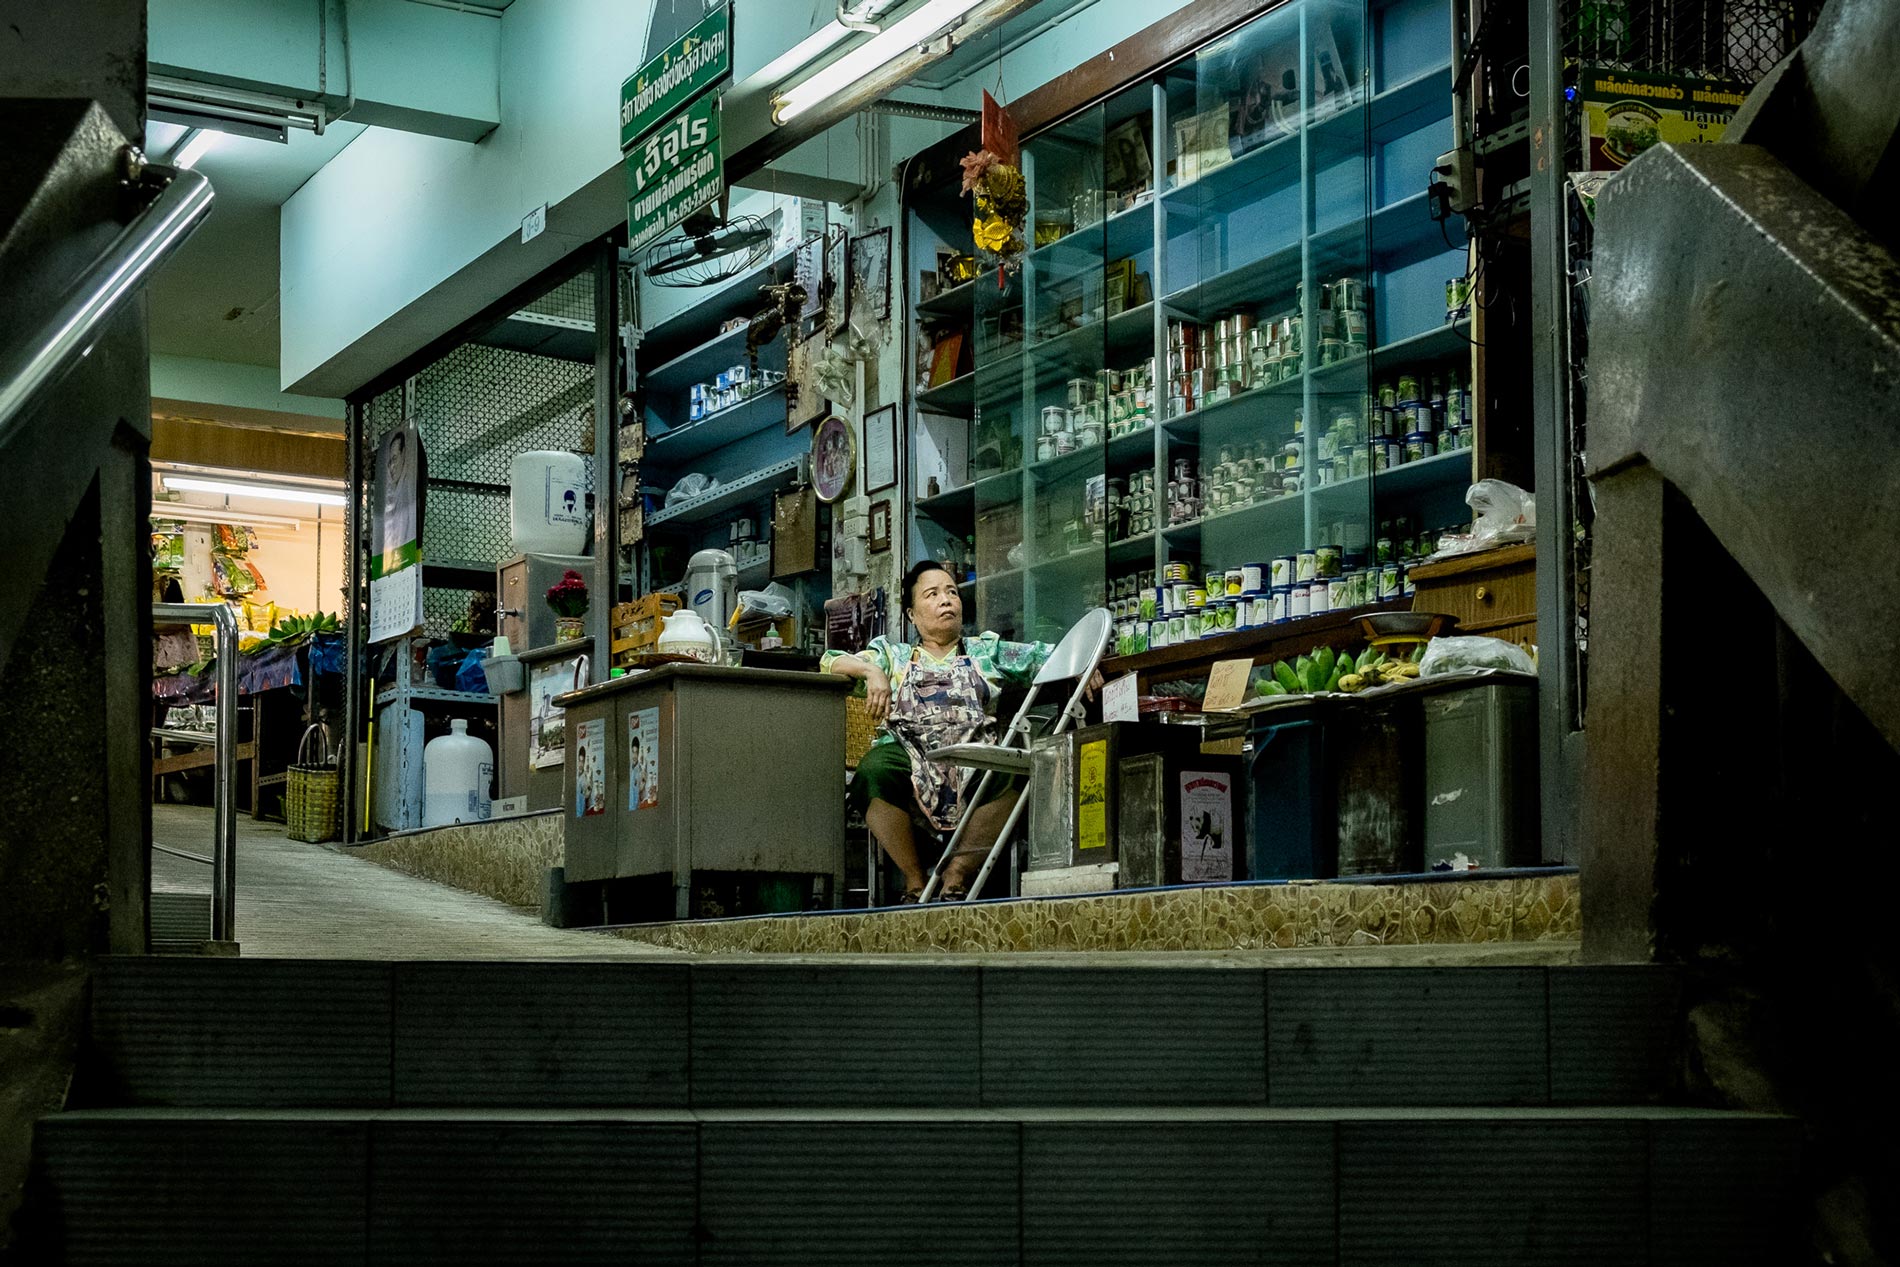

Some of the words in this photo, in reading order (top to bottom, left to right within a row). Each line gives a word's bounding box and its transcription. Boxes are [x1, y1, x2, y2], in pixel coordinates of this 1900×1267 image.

[1594, 75, 1684, 100] เมล็ดผักสวนครัว
[634, 149, 715, 222] ขายเมล็ดพันธุ์ผัก
